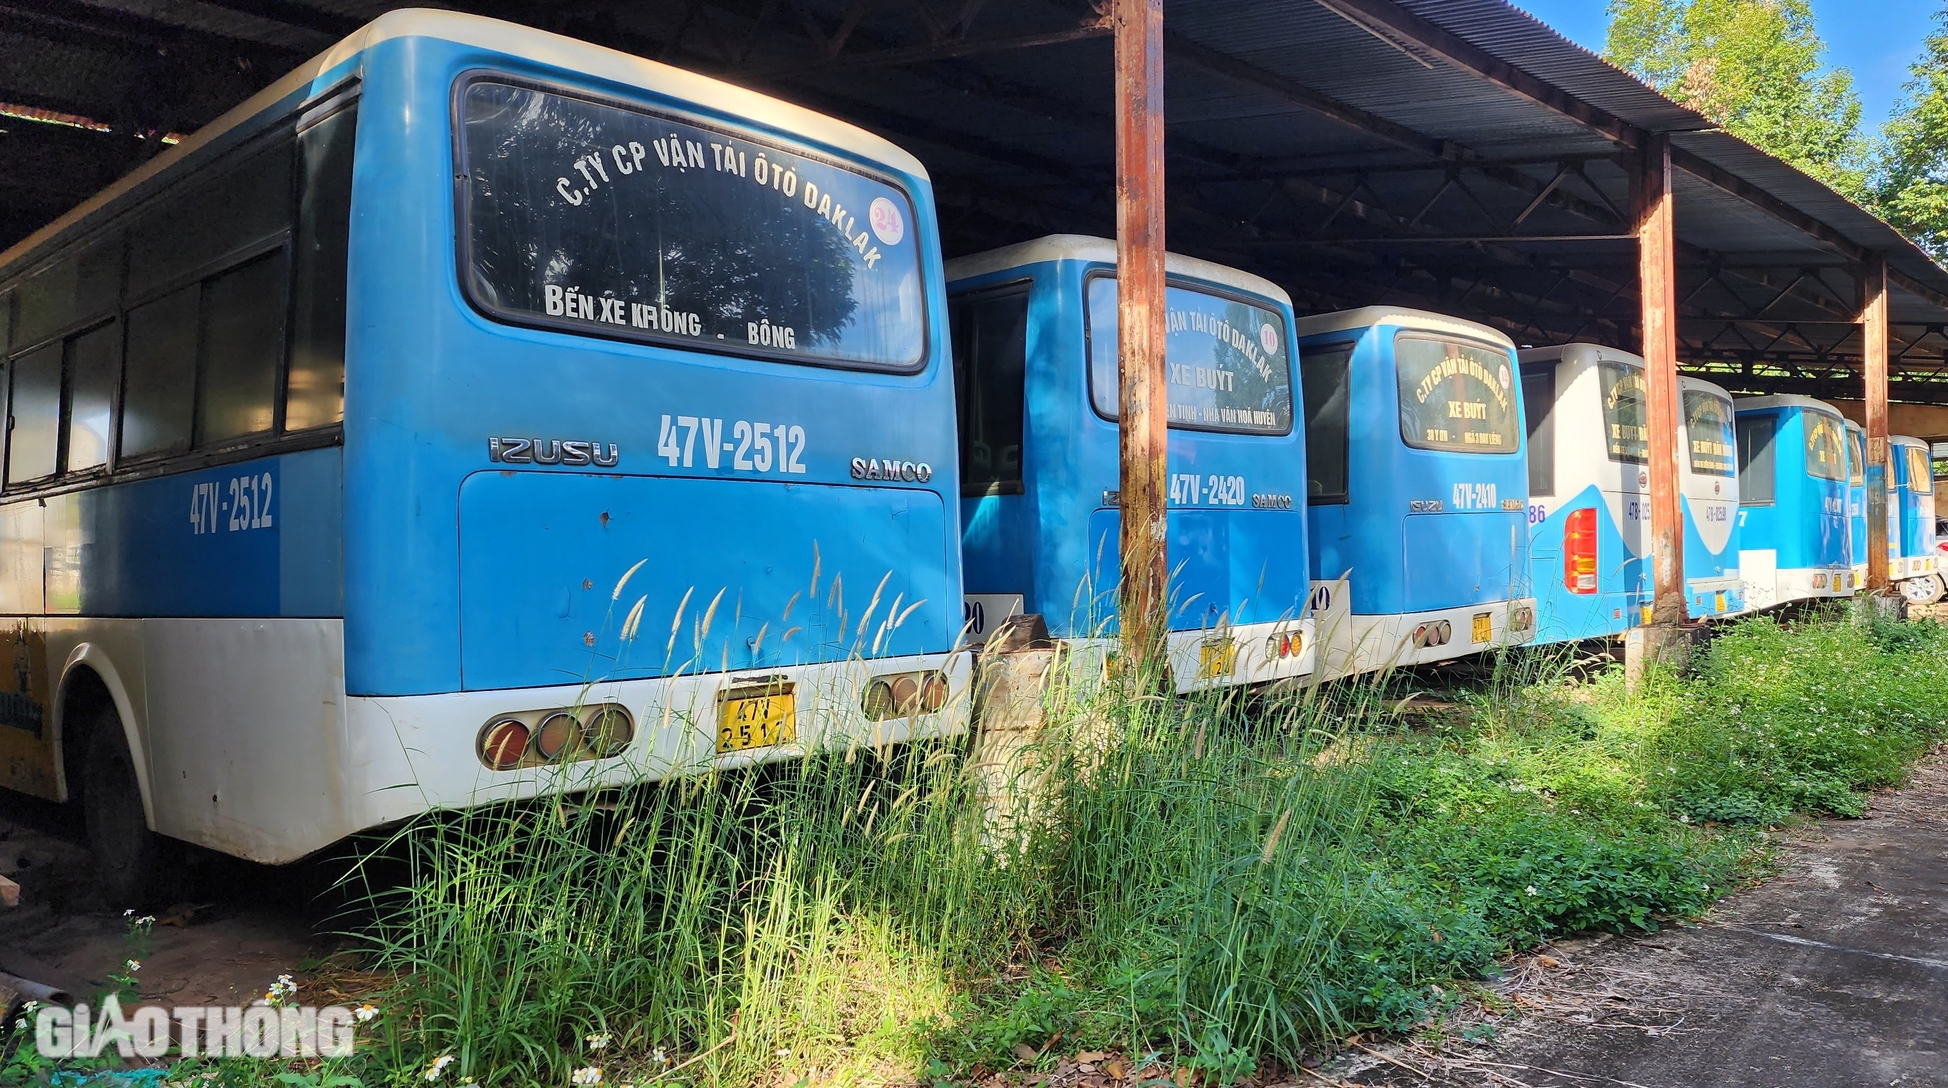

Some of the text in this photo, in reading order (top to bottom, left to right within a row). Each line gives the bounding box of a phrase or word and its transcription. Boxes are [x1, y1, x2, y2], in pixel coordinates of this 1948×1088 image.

[556, 151, 609, 206] C.TY
[612, 141, 645, 175] CP
[804, 181, 881, 269] DAKLAK
[874, 207, 899, 232] 24
[545, 284, 594, 321] BẾN
[599, 297, 626, 325] XE
[747, 318, 796, 350] BÔNG
[1189, 306, 1207, 333] TẢI
[1209, 313, 1230, 343] ÔTÔ
[1231, 328, 1273, 384] DAKLAK
[1262, 329, 1276, 348] 10
[1169, 362, 1234, 392] XE BUÝT
[1416, 374, 1433, 404] C.TY
[1431, 365, 1443, 386] CP
[1220, 406, 1237, 424] VĂN
[1448, 398, 1487, 420] XE BUÝT
[488, 436, 619, 468] IZUSU
[657, 414, 807, 474] 47V-2512
[850, 456, 932, 484] SAMCO
[190, 471, 272, 535] 47V-2512
[1170, 474, 1245, 505] 47V-2420
[1252, 493, 1291, 509] SAMCO
[1453, 483, 1497, 509] 47V-2410
[1410, 499, 1443, 512] ISUZU
[1529, 505, 1546, 524] 86
